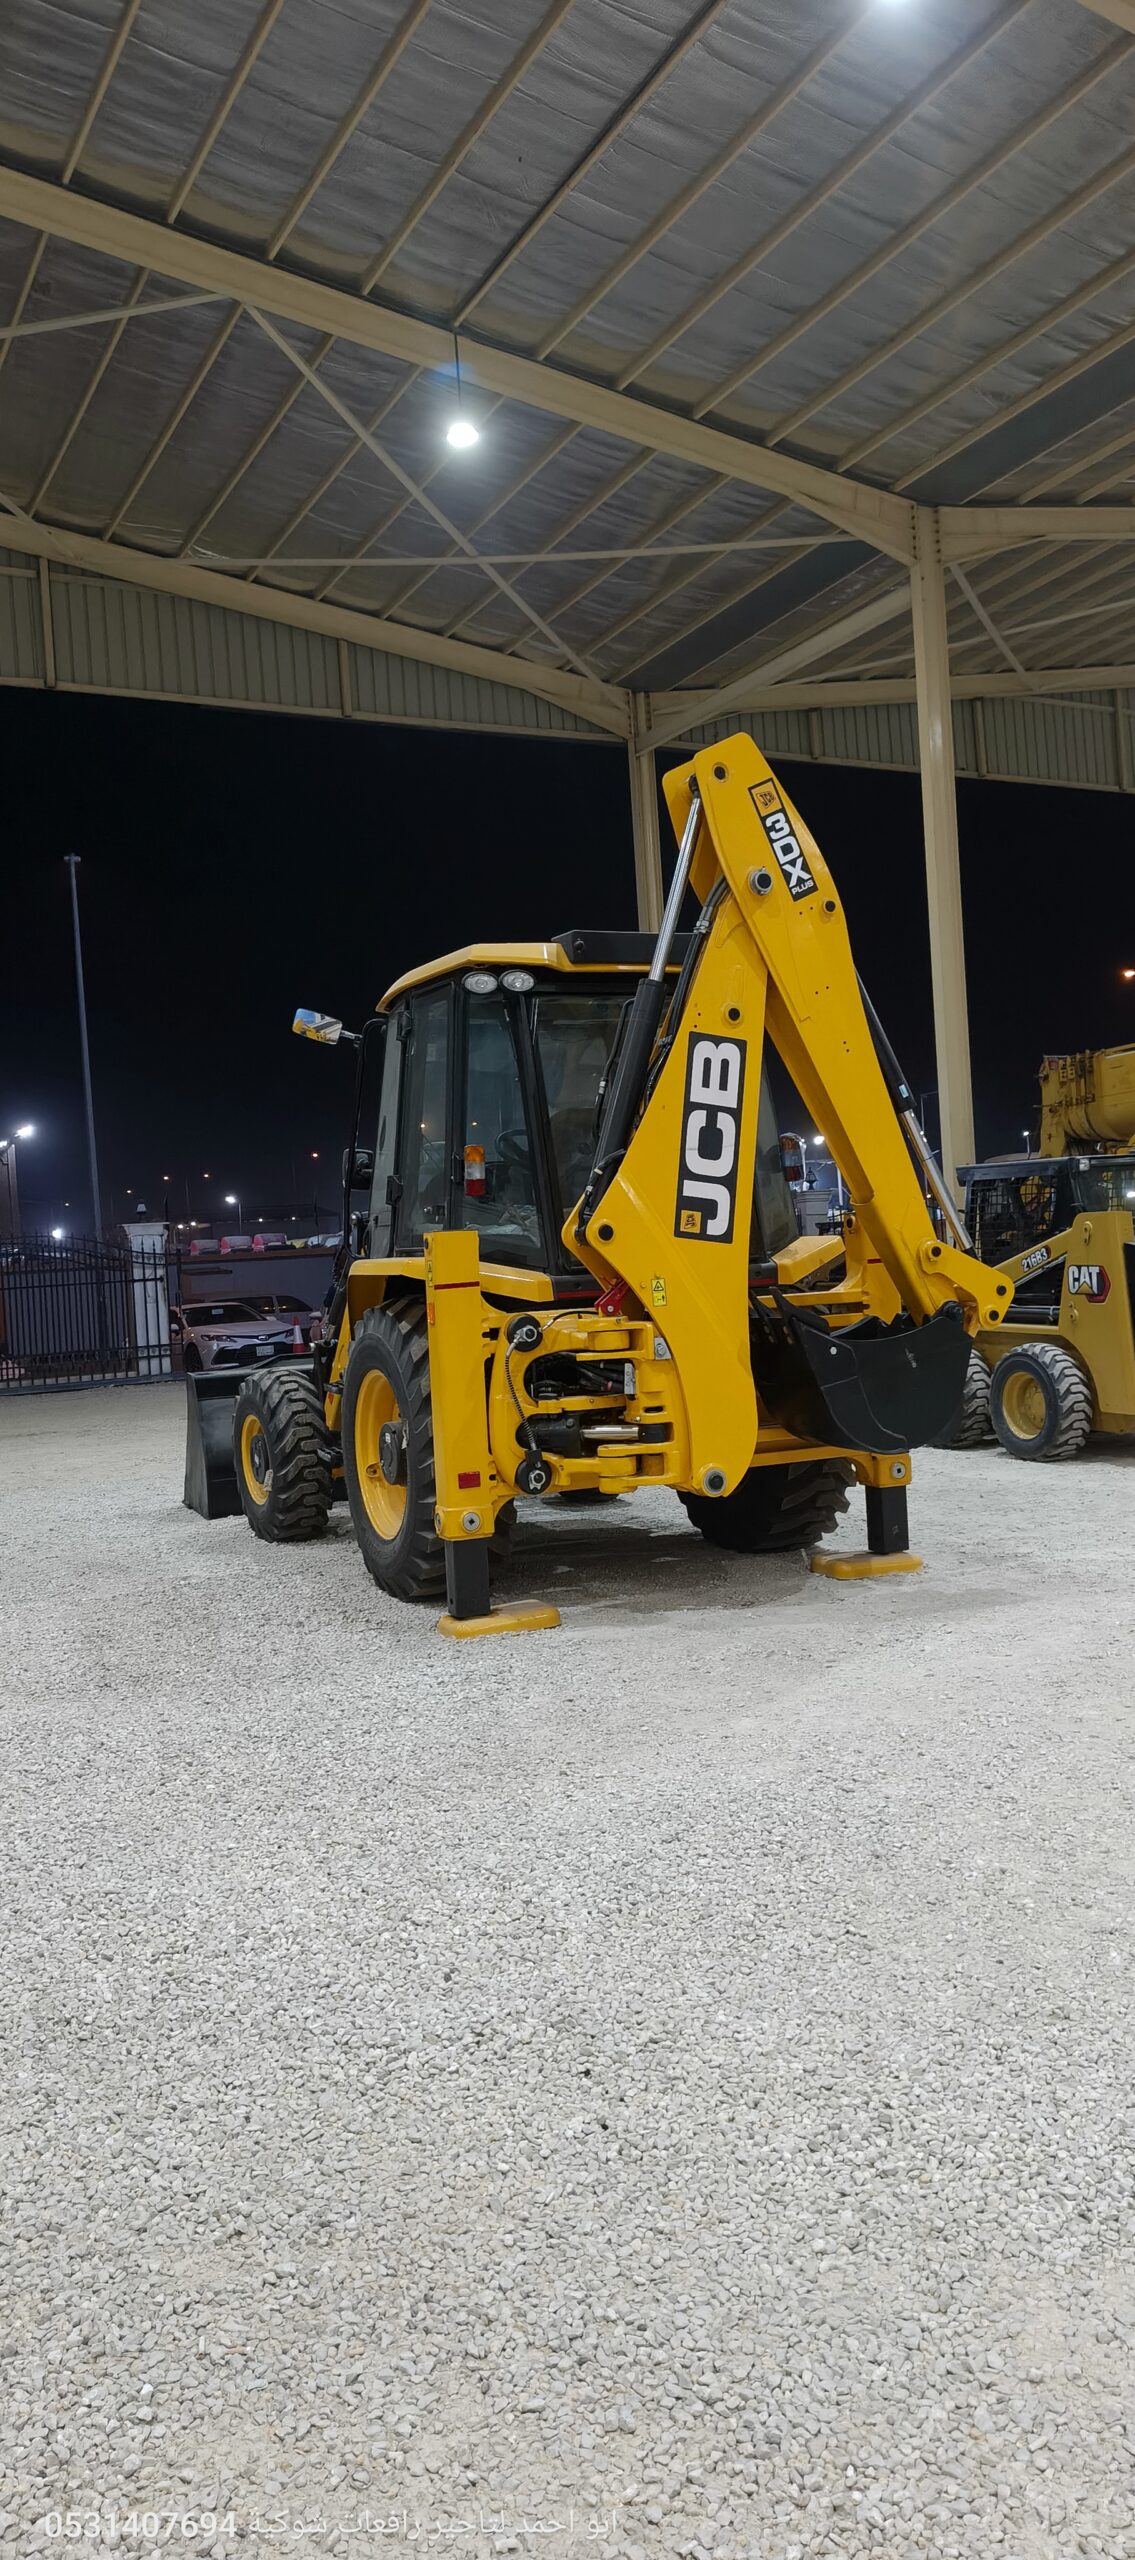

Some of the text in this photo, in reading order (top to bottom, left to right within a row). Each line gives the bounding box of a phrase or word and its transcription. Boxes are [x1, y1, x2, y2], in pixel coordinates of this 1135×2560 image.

[765, 812, 812, 888] 3DX
[791, 880, 814, 895] PLUS
[682, 1040, 741, 1236] JCB
[1021, 1247, 1048, 1272] 216B3
[1068, 1265, 1099, 1294] CAT
